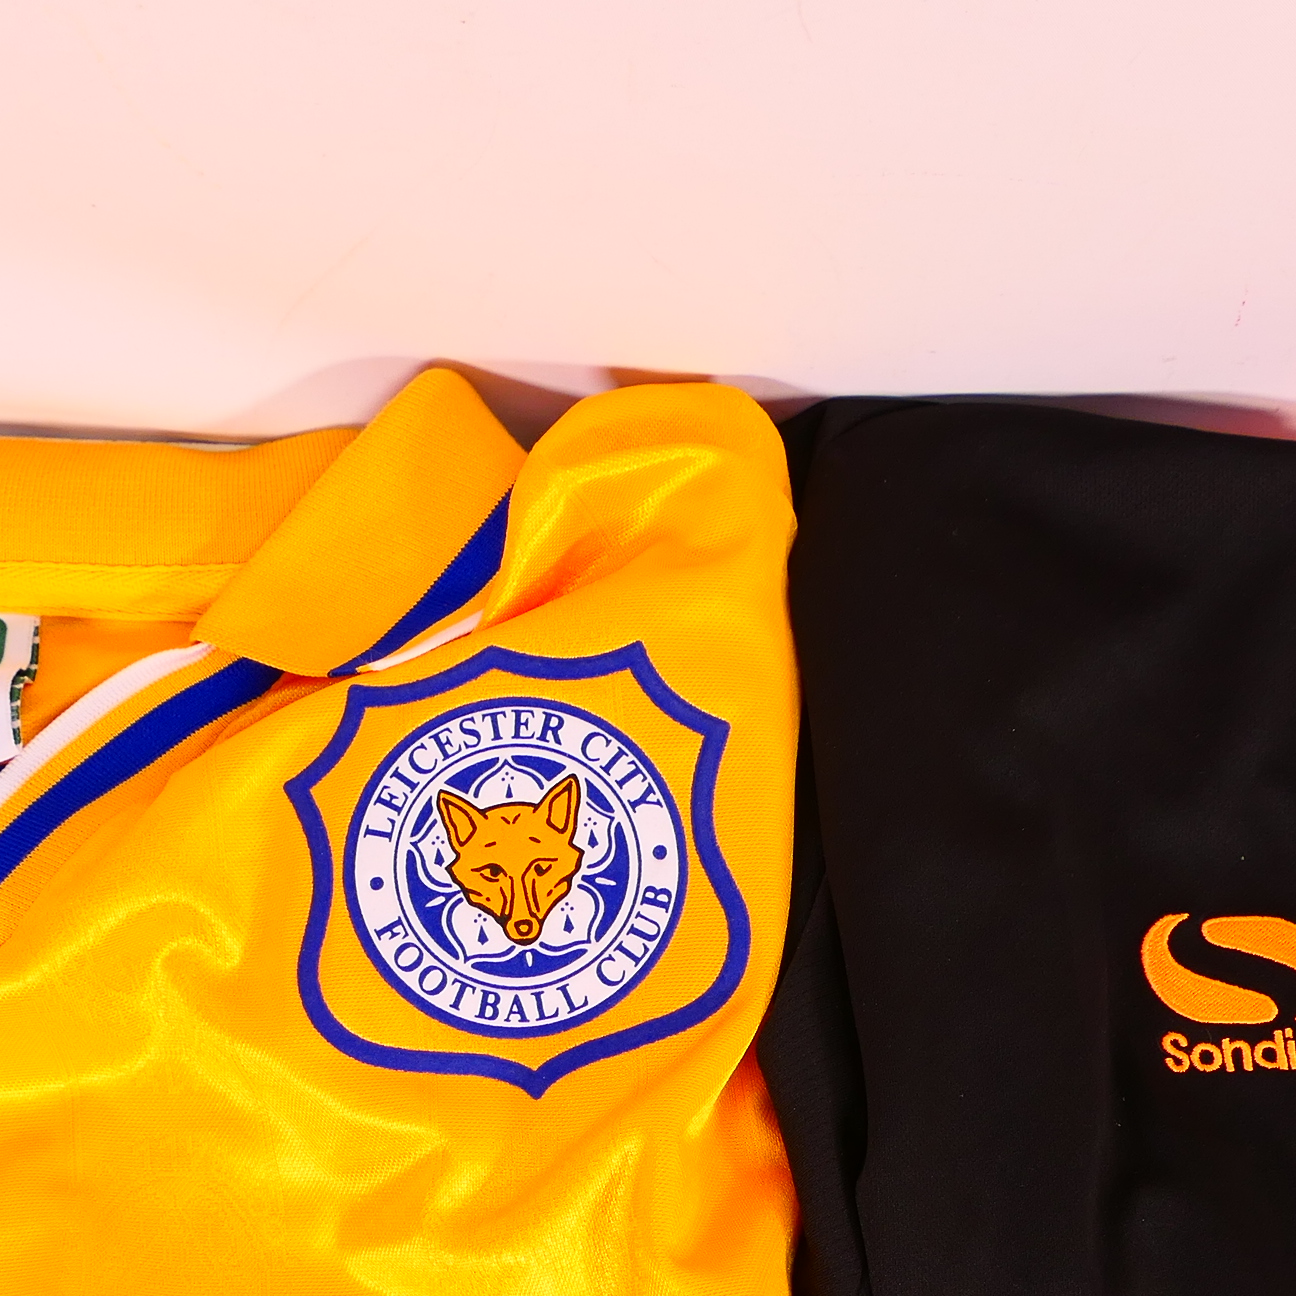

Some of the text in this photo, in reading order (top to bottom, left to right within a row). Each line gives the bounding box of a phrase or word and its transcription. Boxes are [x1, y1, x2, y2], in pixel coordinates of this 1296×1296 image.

[363, 710, 664, 841] LEICESTER CITY
[374, 885, 672, 1023] FOOTBALL CLUB
